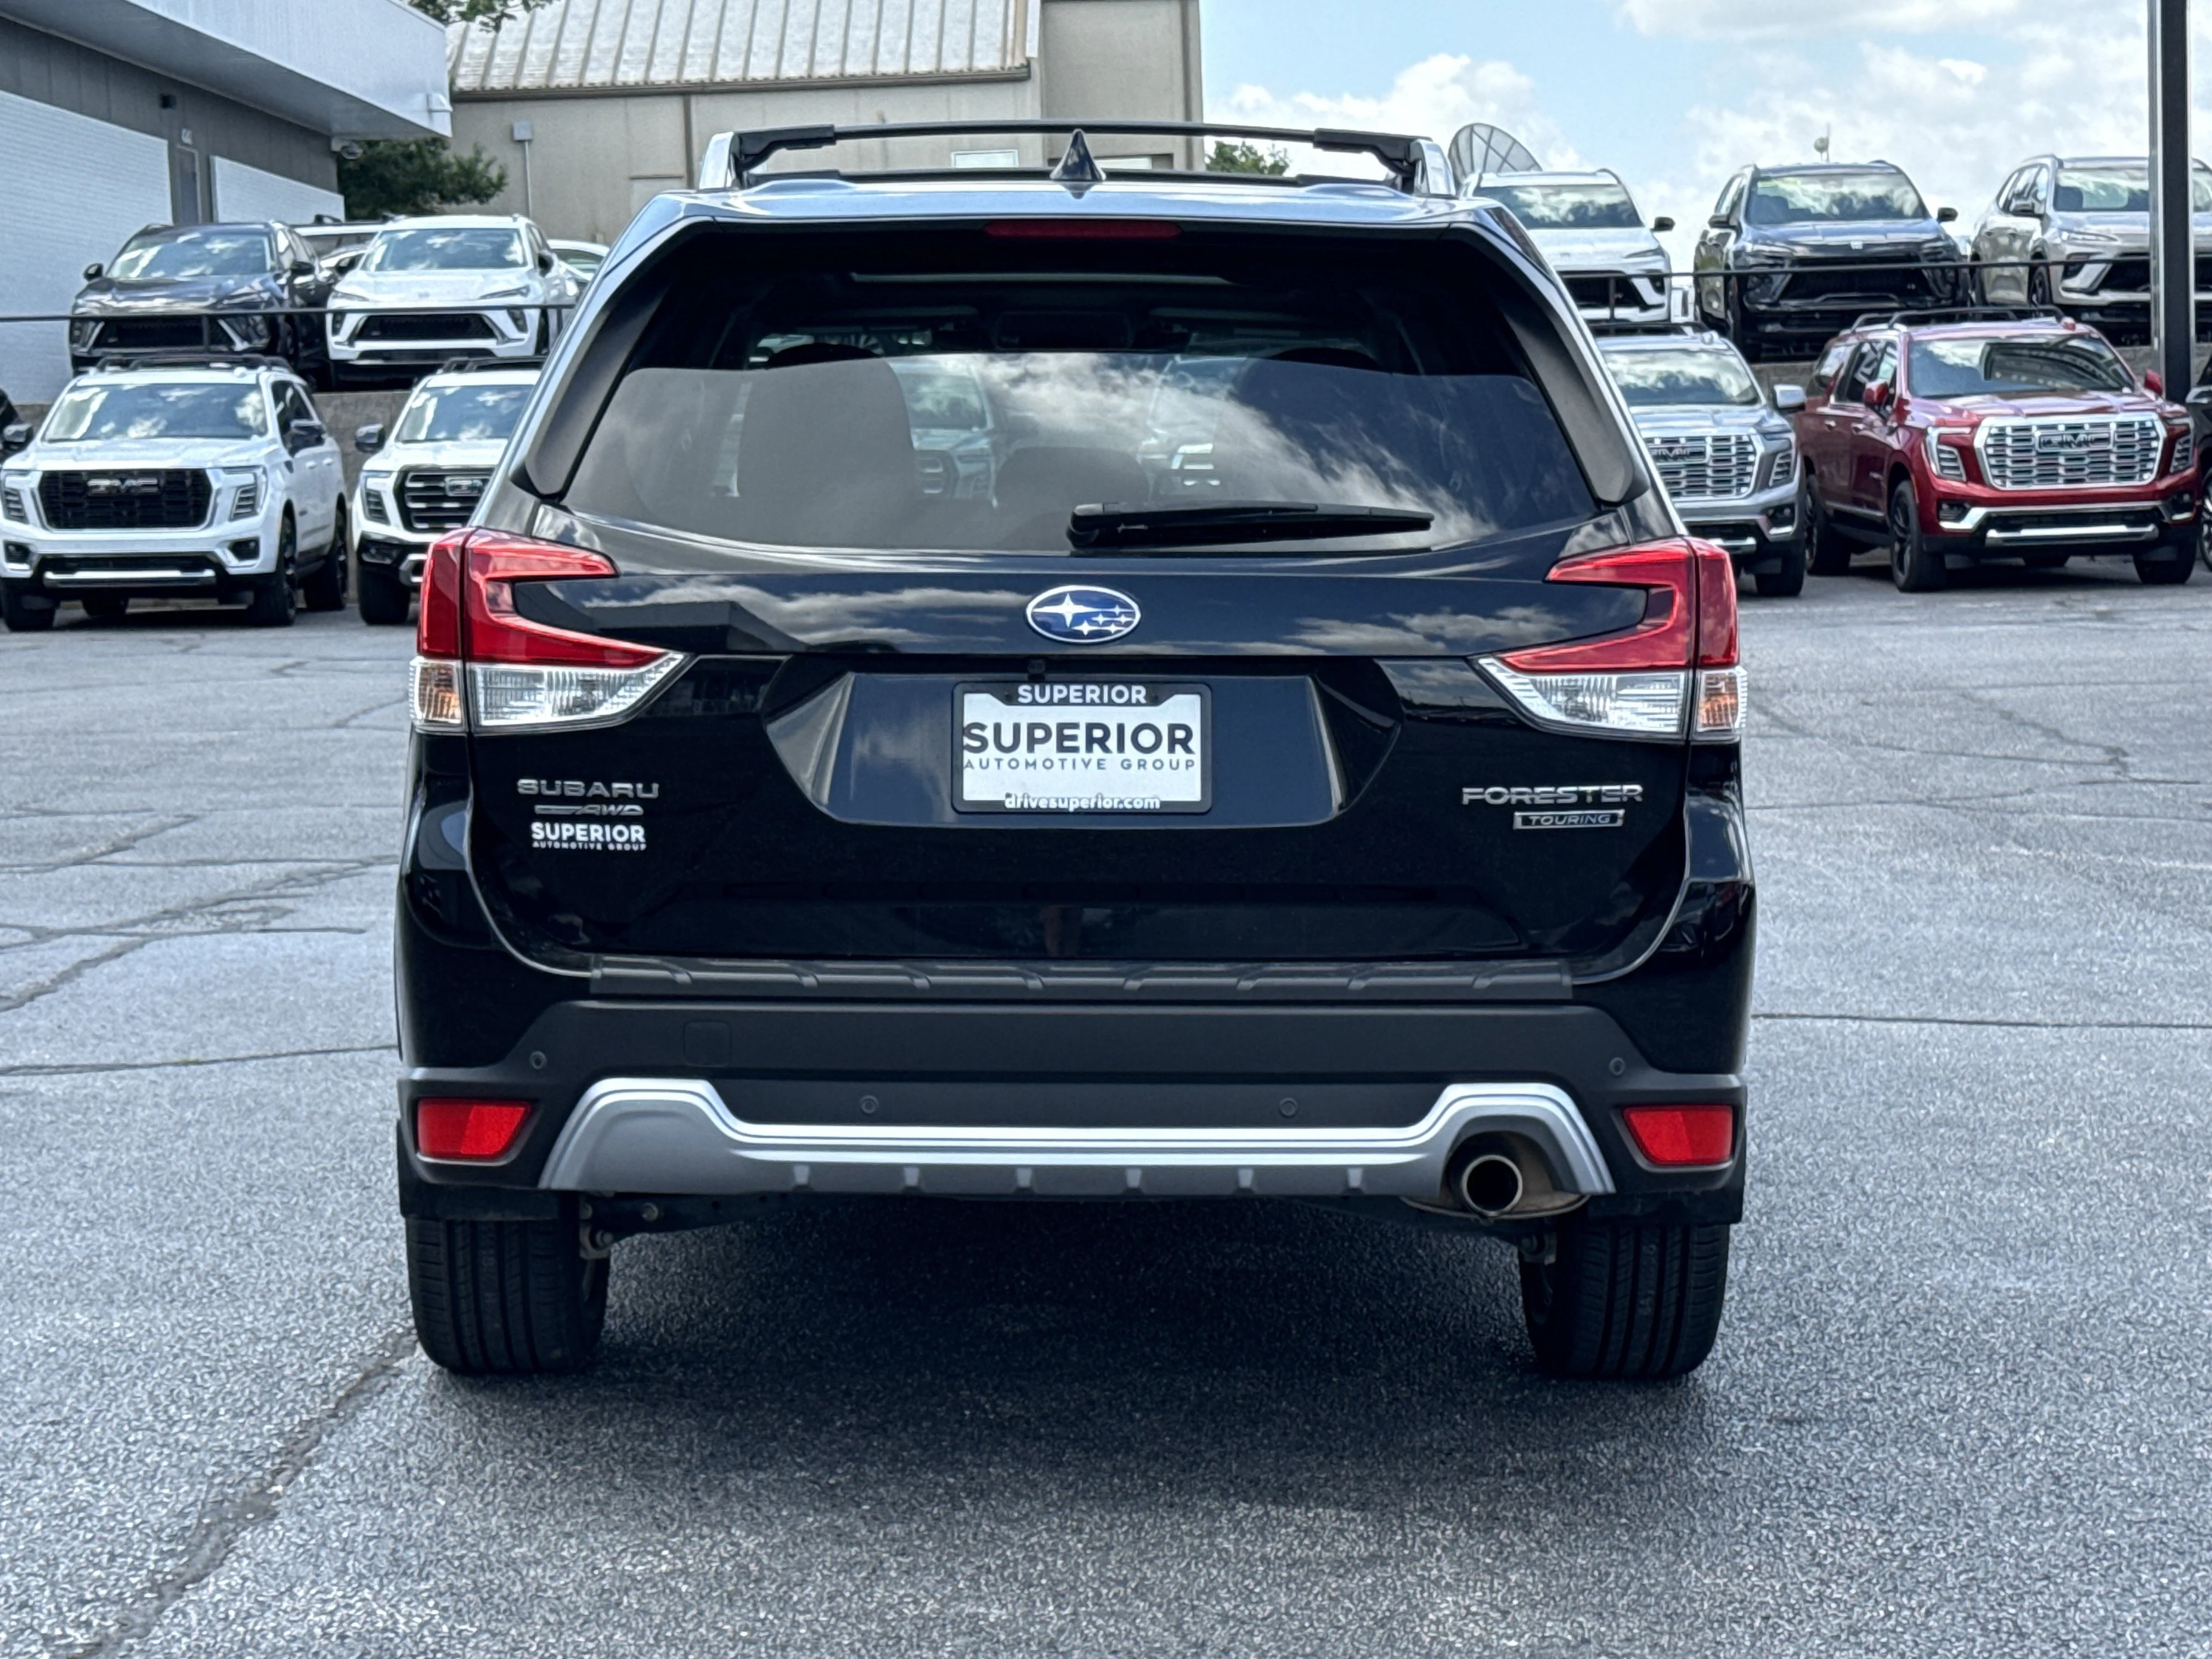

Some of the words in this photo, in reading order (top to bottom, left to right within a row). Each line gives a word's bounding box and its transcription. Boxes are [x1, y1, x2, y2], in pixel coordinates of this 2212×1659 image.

[1017, 684, 1147, 704] SUPERIOR
[963, 722, 1195, 754] SUPERIOR
[964, 757, 1107, 770] AUTOMOTIVE
[1120, 759, 1195, 771] GROUP
[517, 778, 659, 799] SUBARU
[1462, 784, 1643, 804] FORESTER
[574, 804, 644, 816] AWD
[1005, 793, 1160, 811] drivesuperior.com
[1528, 815, 1611, 826] TOURING
[531, 822, 646, 842] SUPERIOR
[532, 841, 603, 850] AUTOMOTIVE
[607, 843, 647, 851] GROUP
